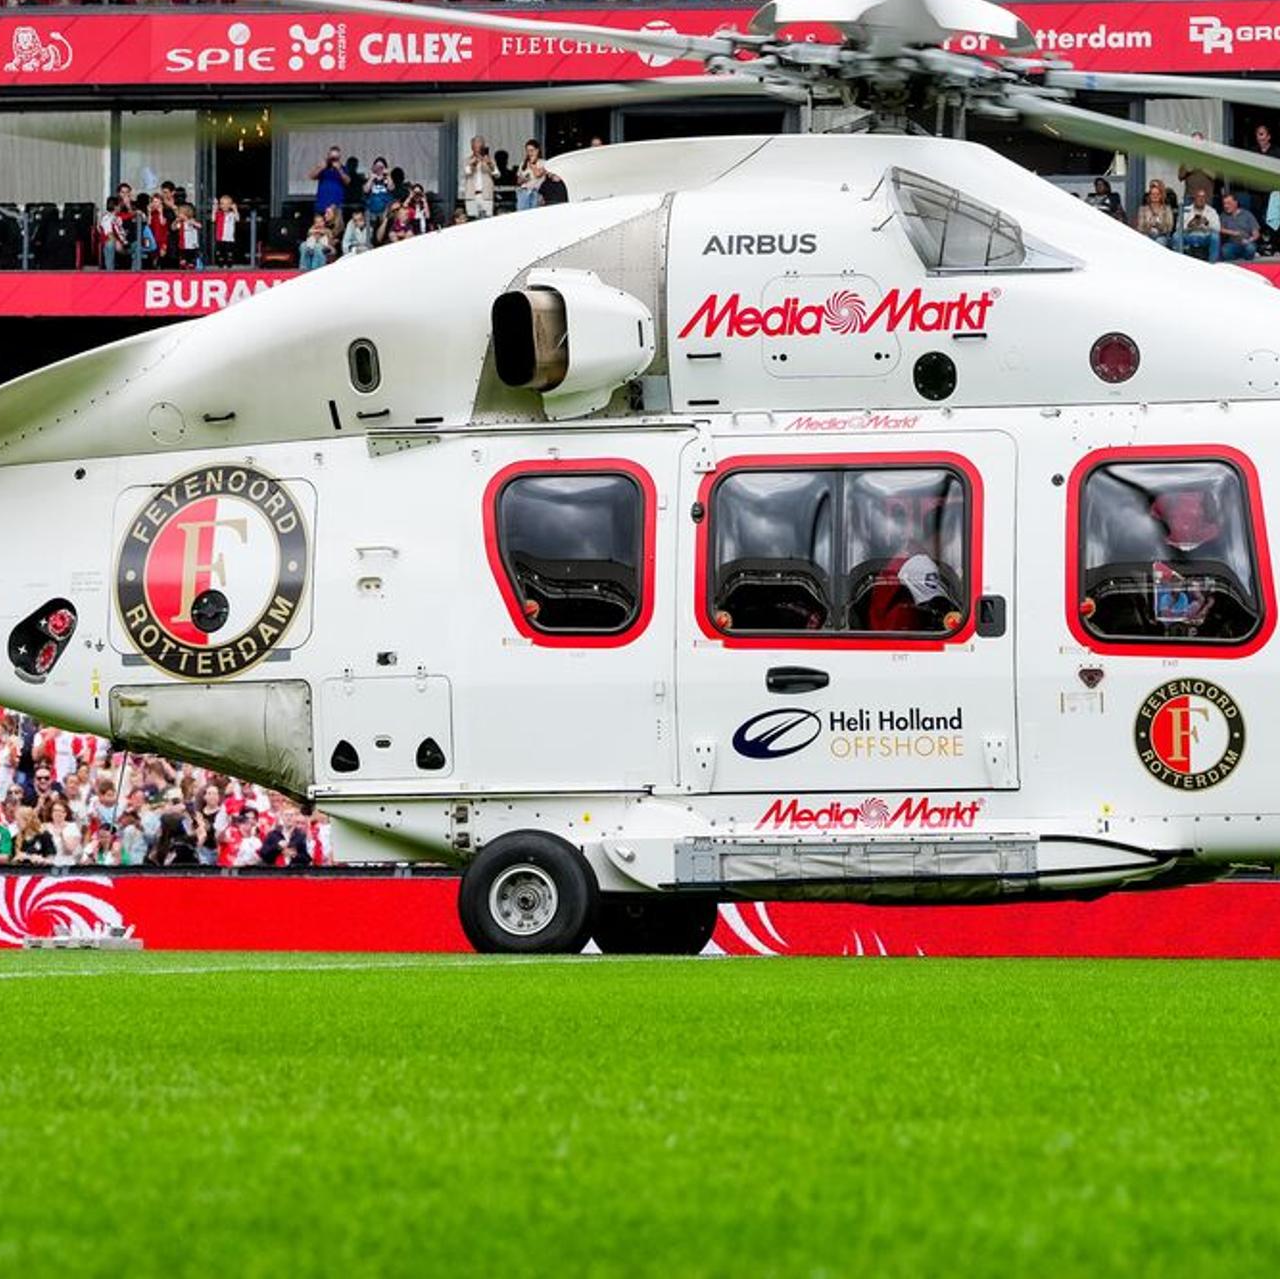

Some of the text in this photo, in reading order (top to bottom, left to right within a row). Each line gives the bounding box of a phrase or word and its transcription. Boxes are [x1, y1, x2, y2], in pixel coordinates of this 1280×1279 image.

[359, 32, 463, 65] CALEX
[1035, 24, 1153, 49] tterdam
[702, 233, 818, 255] AIRBUS
[145, 280, 288, 309] BURA
[677, 288, 994, 338] Media Markt
[132, 469, 298, 544] FEYENOORD
[125, 594, 295, 674] ROTTERDAM
[1140, 680, 1238, 719] FEYENOORD
[829, 707, 962, 732] Heli Holland
[830, 735, 964, 759] OFFSHORE
[1140, 748, 1239, 788] ROTTERDAM
[754, 797, 981, 830] Media Markt
